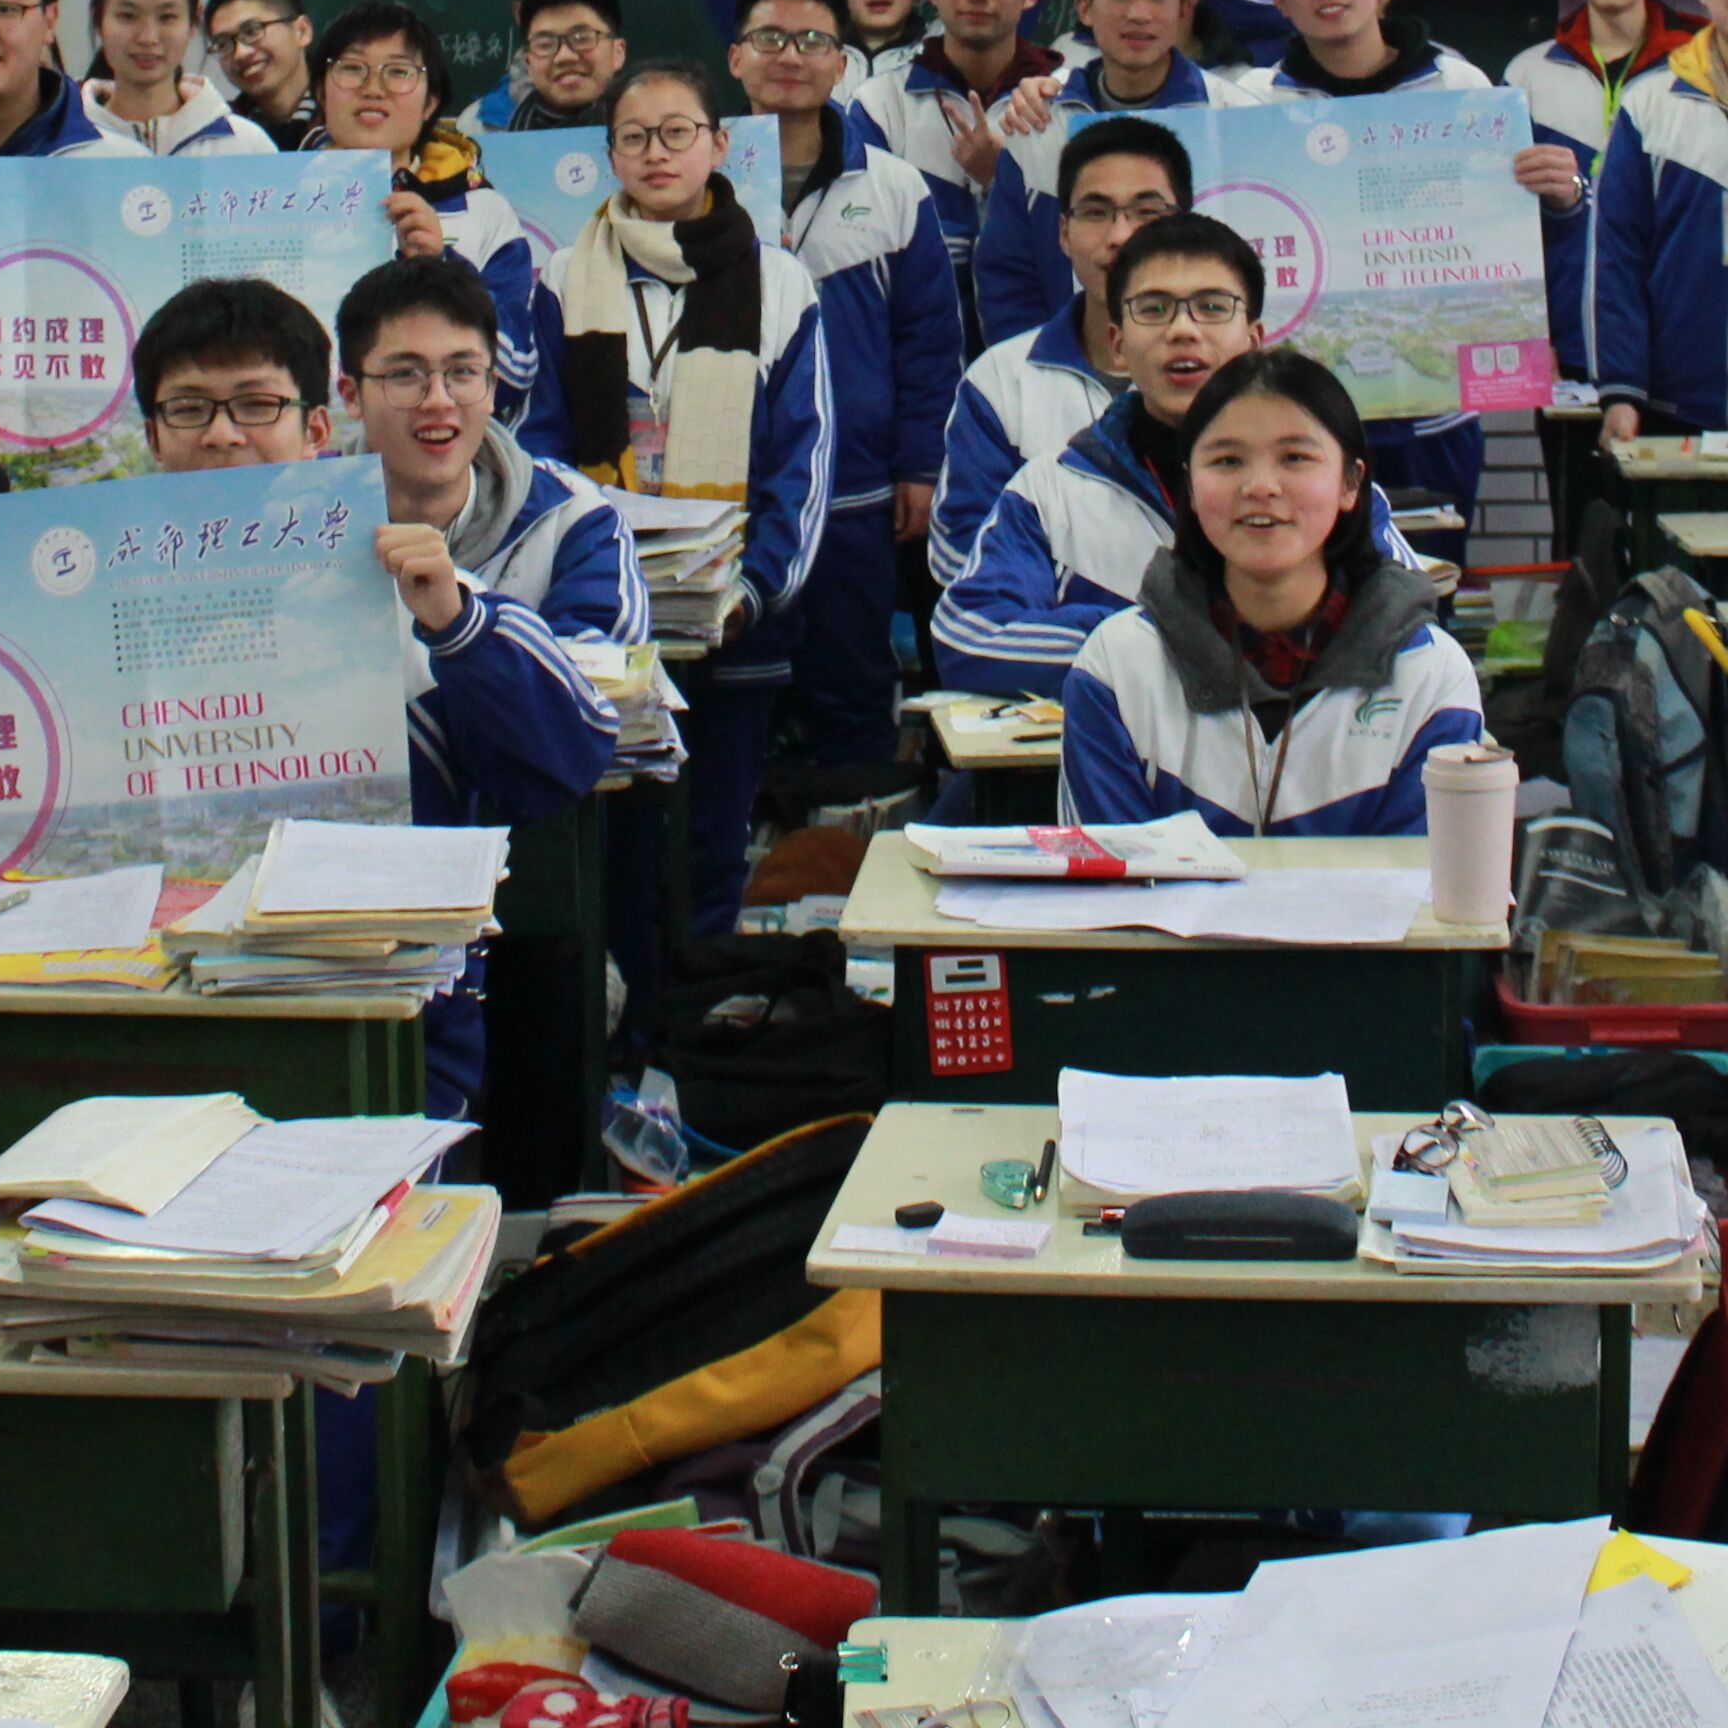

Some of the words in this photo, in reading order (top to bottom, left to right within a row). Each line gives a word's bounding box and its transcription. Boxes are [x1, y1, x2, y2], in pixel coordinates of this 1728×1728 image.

[1360, 113, 1509, 148] 成都理工大学
[179, 180, 365, 223] 成都理工大学
[1362, 224, 1455, 247] CHENGDU
[1363, 245, 1475, 266] UNIVERSITY
[1365, 268, 1386, 288] OF
[1402, 261, 1523, 288] TECHNOLOGY
[107, 497, 352, 571] 成都理工大学
[120, 692, 265, 730] CHENGDU
[122, 722, 303, 763] UNIVERSITY
[127, 770, 158, 798] OF
[183, 746, 384, 794] TECHNOLOGY
